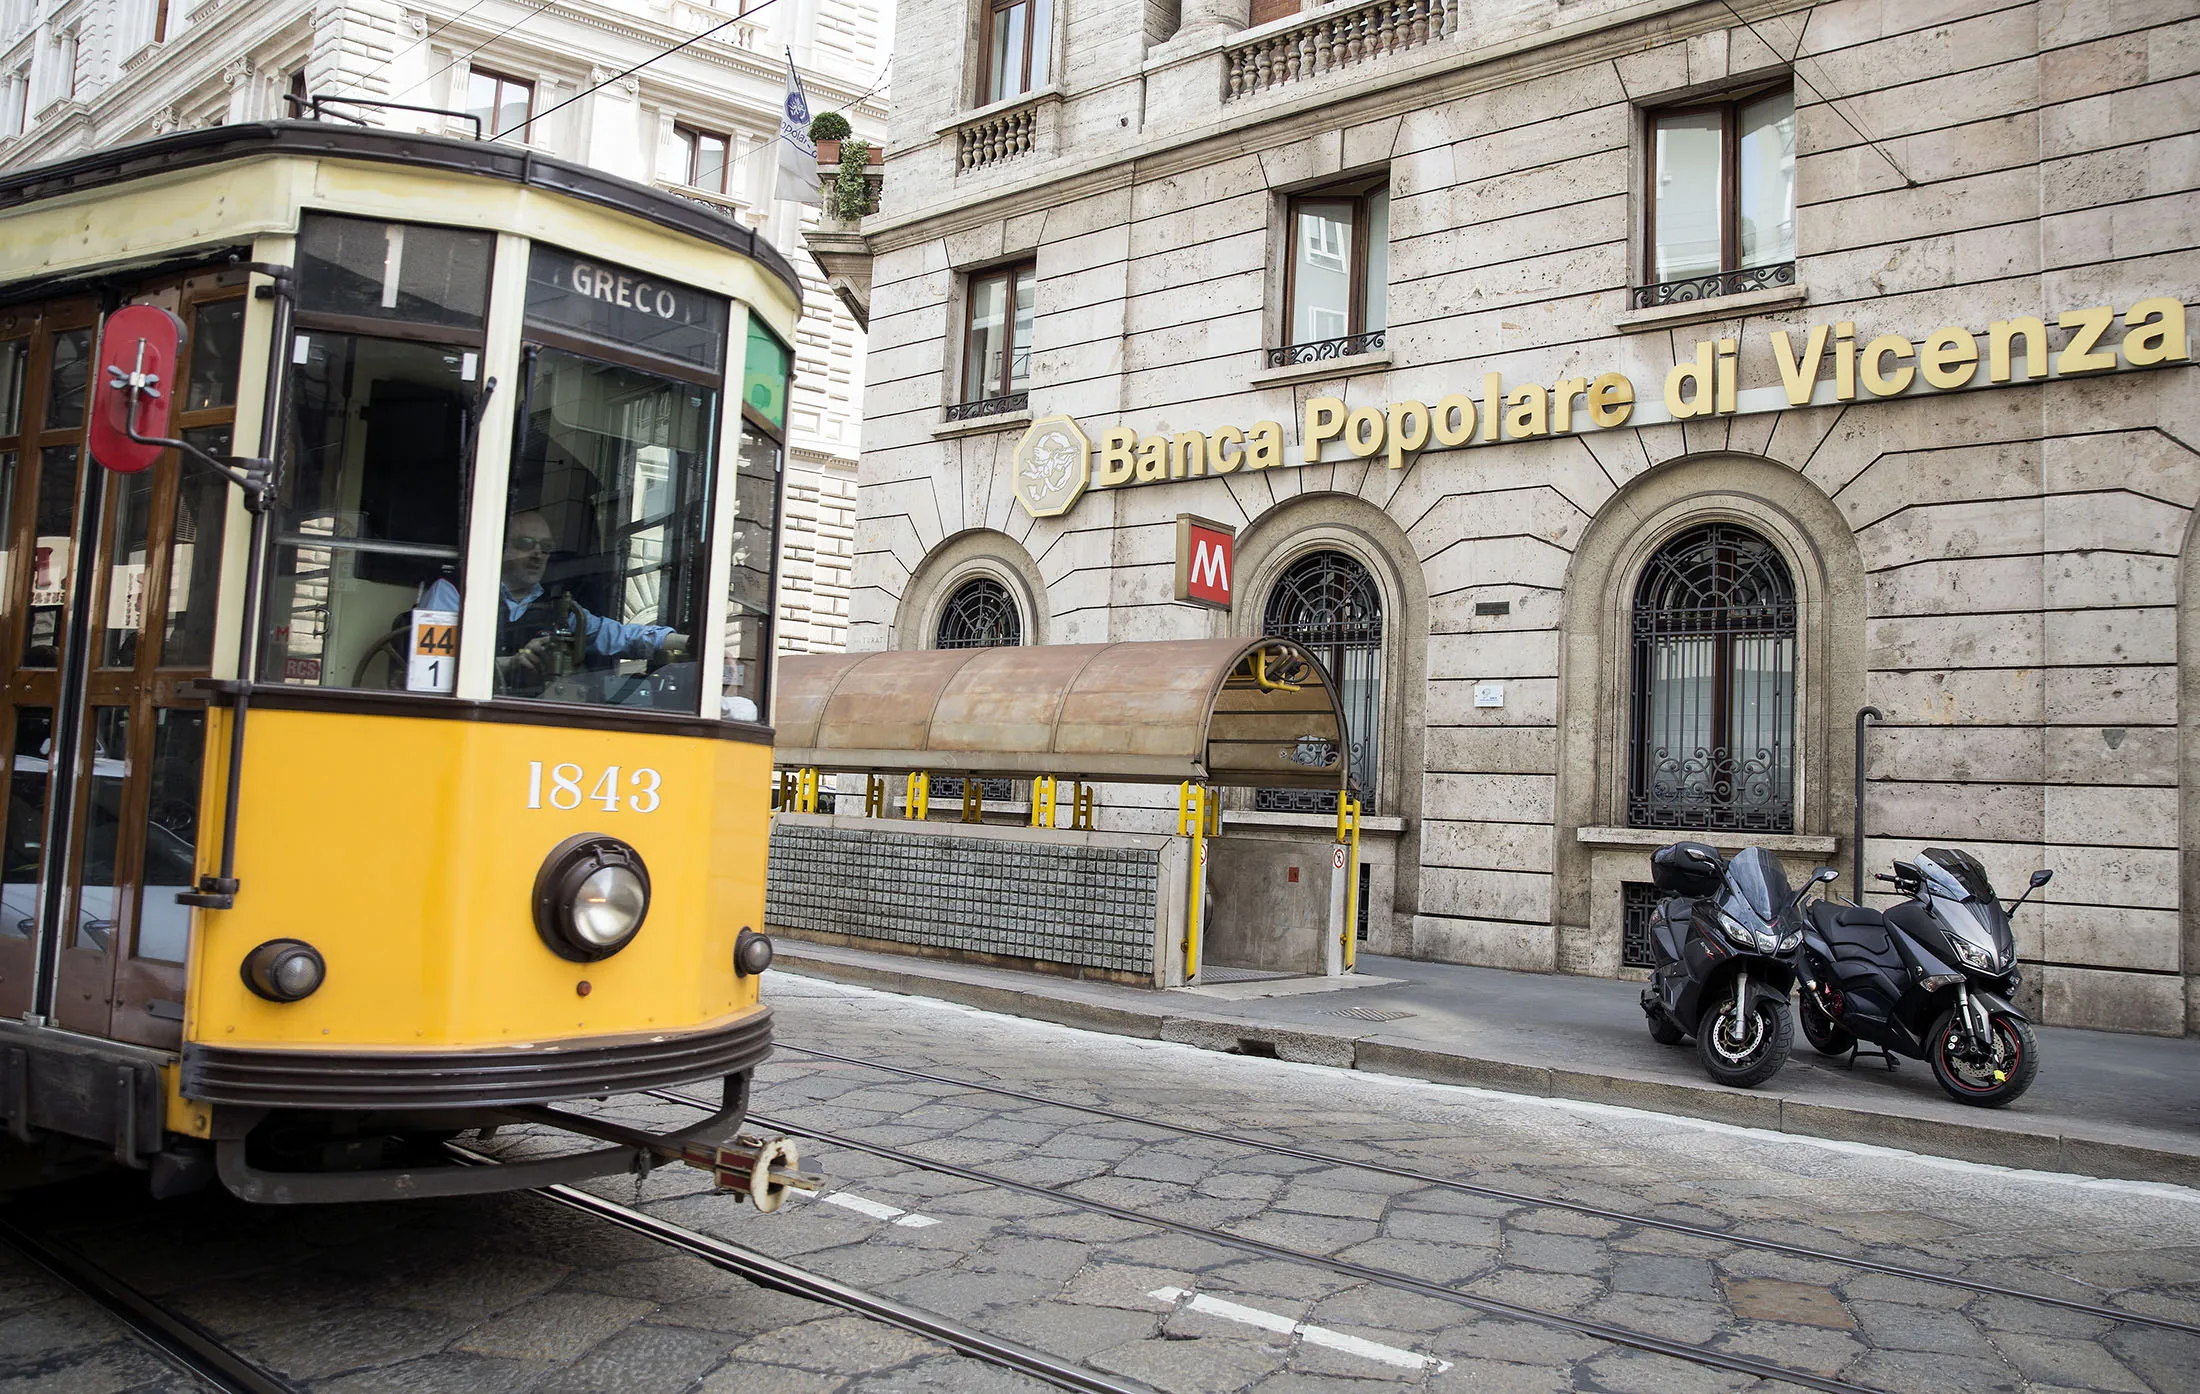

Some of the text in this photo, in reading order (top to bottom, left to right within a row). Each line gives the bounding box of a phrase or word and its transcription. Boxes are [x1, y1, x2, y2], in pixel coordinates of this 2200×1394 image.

[572, 263, 676, 319] GRECO
[1100, 297, 2190, 487] Banca Popolare di Vicenza
[1191, 540, 1229, 591] M
[420, 627, 454, 655] 44
[287, 661, 318, 677] RCS
[428, 661, 440, 687] 1
[527, 761, 662, 814] 1843
